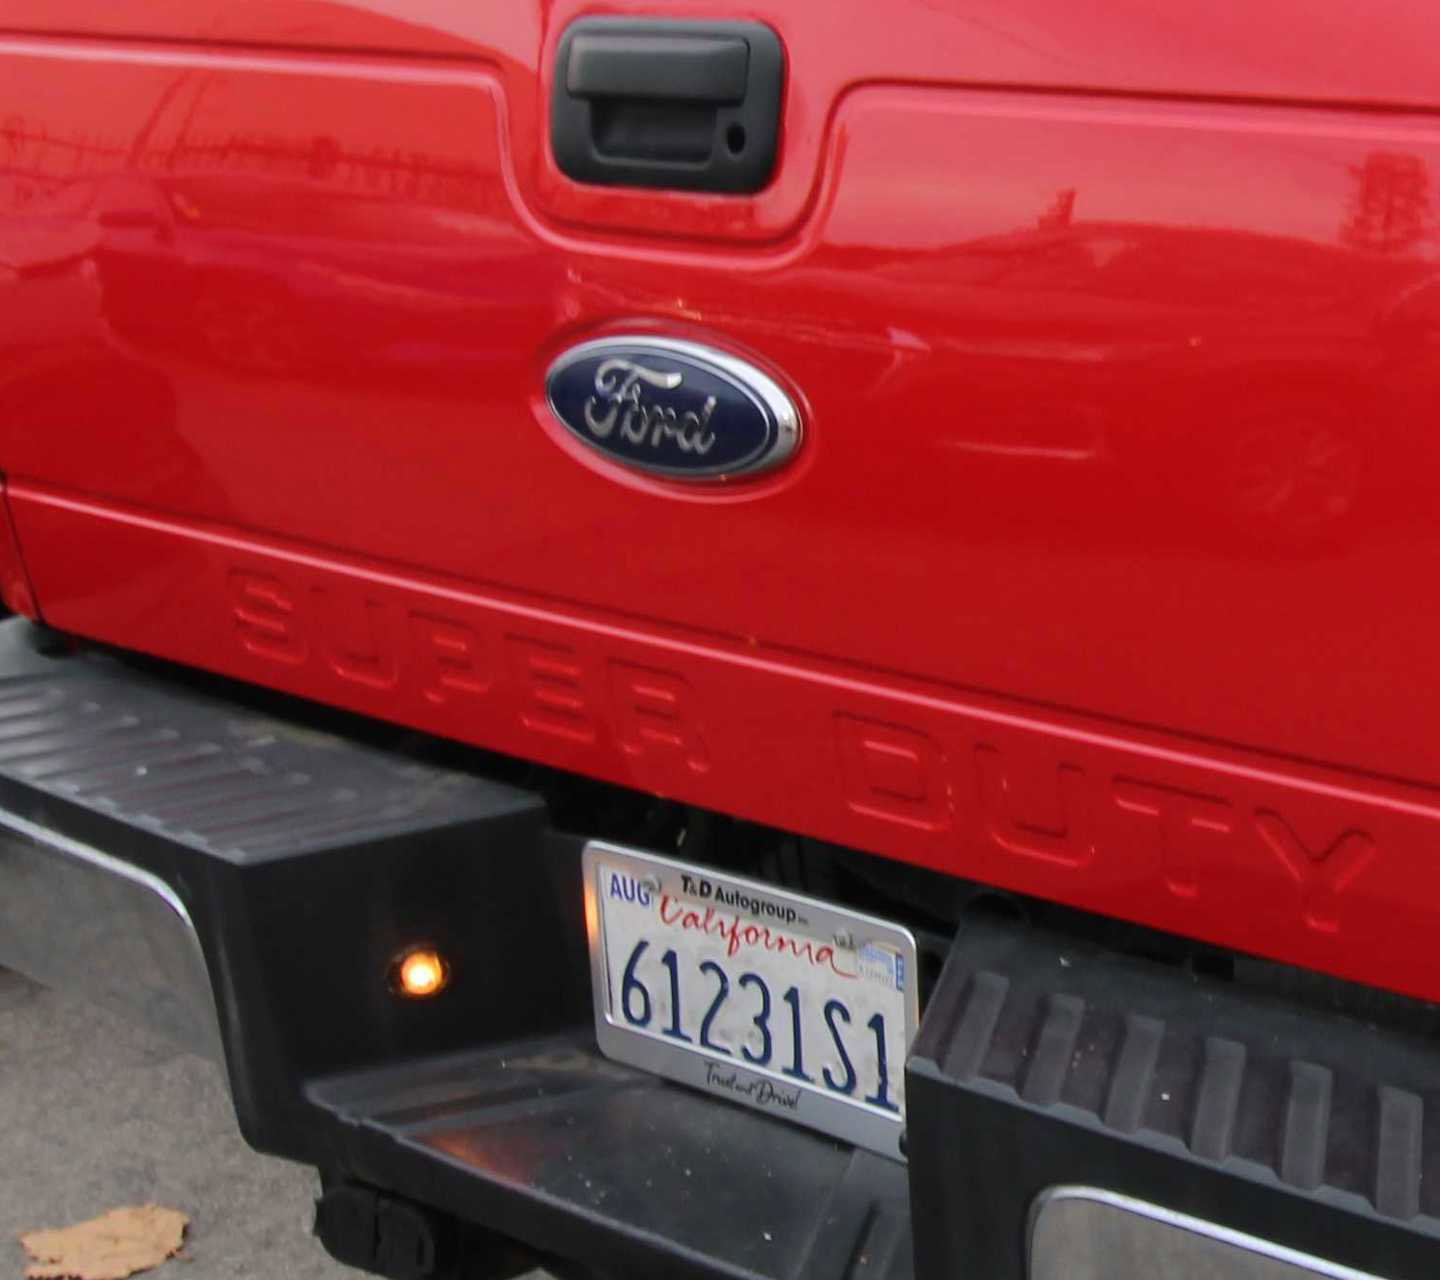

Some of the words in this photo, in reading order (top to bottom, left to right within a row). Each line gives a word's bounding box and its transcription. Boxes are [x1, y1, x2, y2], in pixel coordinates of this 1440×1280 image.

[584, 358, 717, 455] Ford
[227, 566, 711, 776] SUPER
[832, 709, 1378, 935] DUTY
[610, 873, 651, 908] AUG
[660, 893, 859, 980] California
[715, 886, 797, 924] Autogroup
[620, 939, 903, 1113] 61231S1
